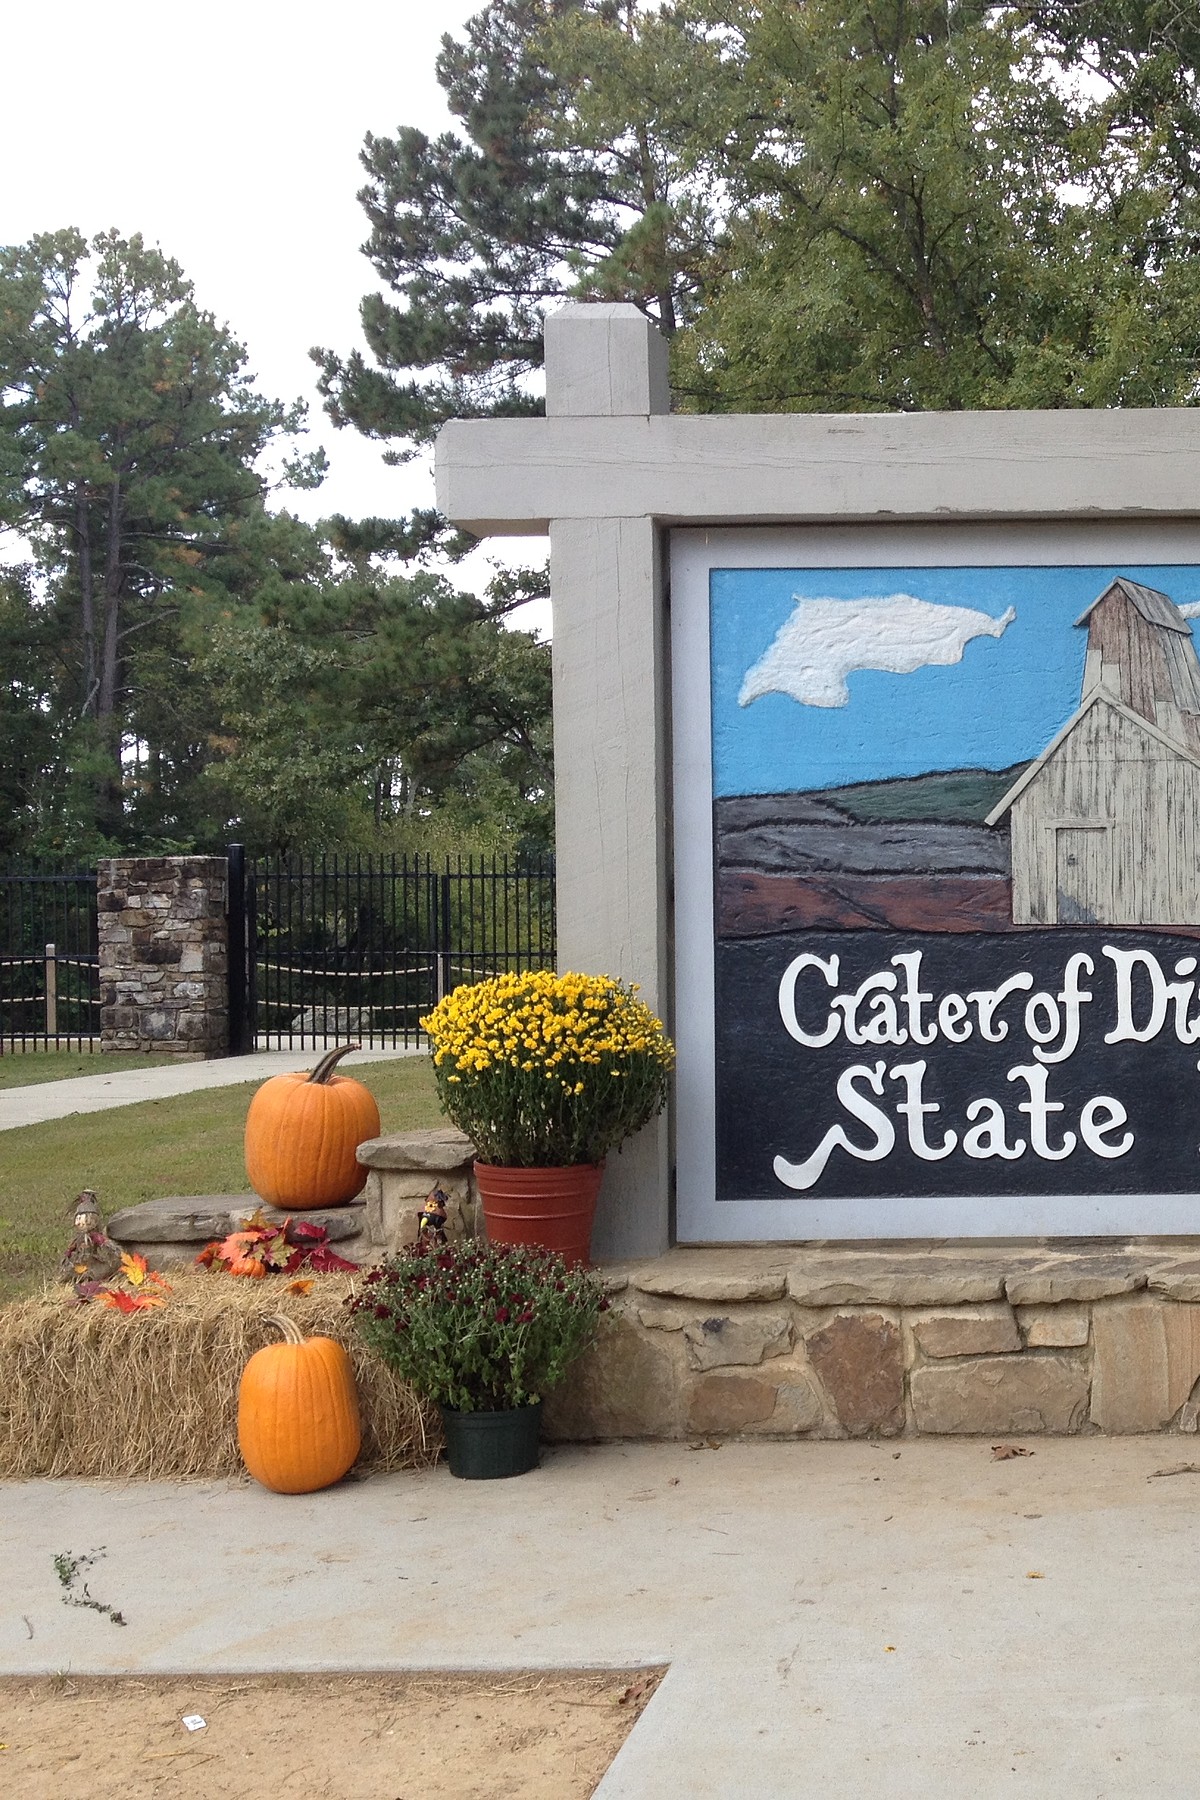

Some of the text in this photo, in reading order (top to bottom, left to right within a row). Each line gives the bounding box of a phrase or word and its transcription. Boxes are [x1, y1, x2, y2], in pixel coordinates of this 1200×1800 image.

[778, 951, 1034, 1049] Crater
[1024, 951, 1096, 1064] of
[772, 1058, 1136, 1190] State
